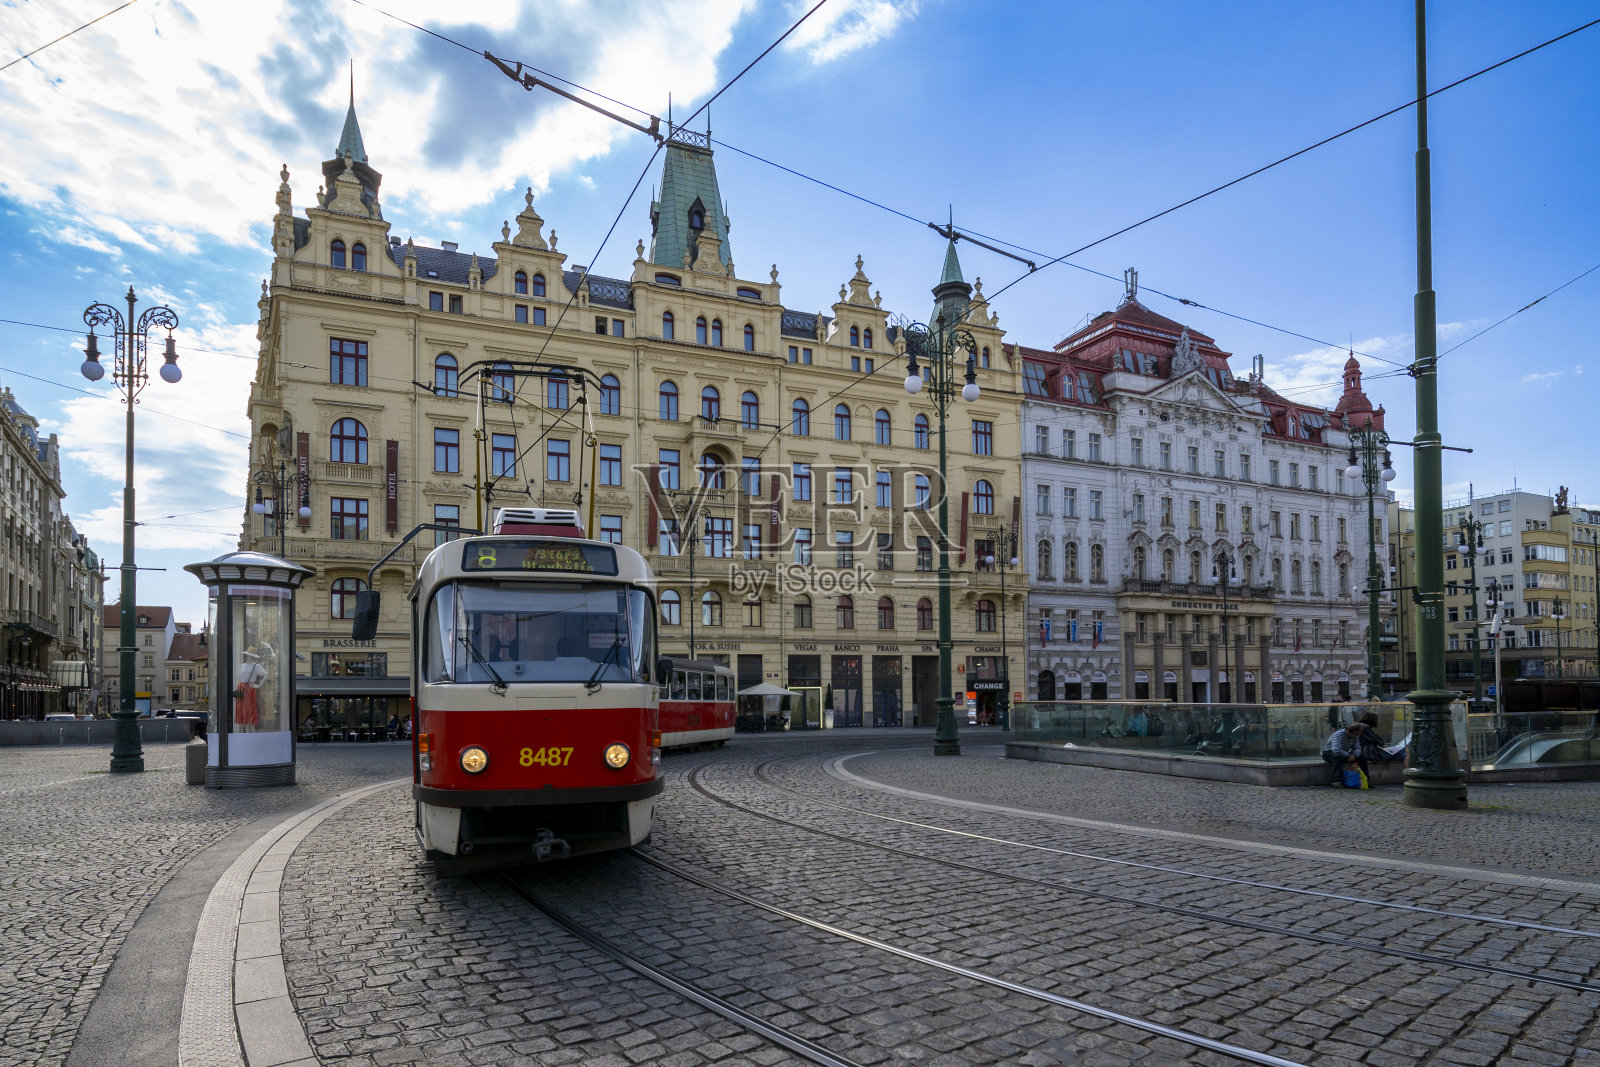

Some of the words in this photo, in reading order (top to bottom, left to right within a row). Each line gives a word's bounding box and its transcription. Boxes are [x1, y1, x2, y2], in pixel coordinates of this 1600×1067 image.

[478, 547, 497, 569] 8
[973, 682, 1004, 690] CHANGE
[520, 747, 574, 766] 8487
